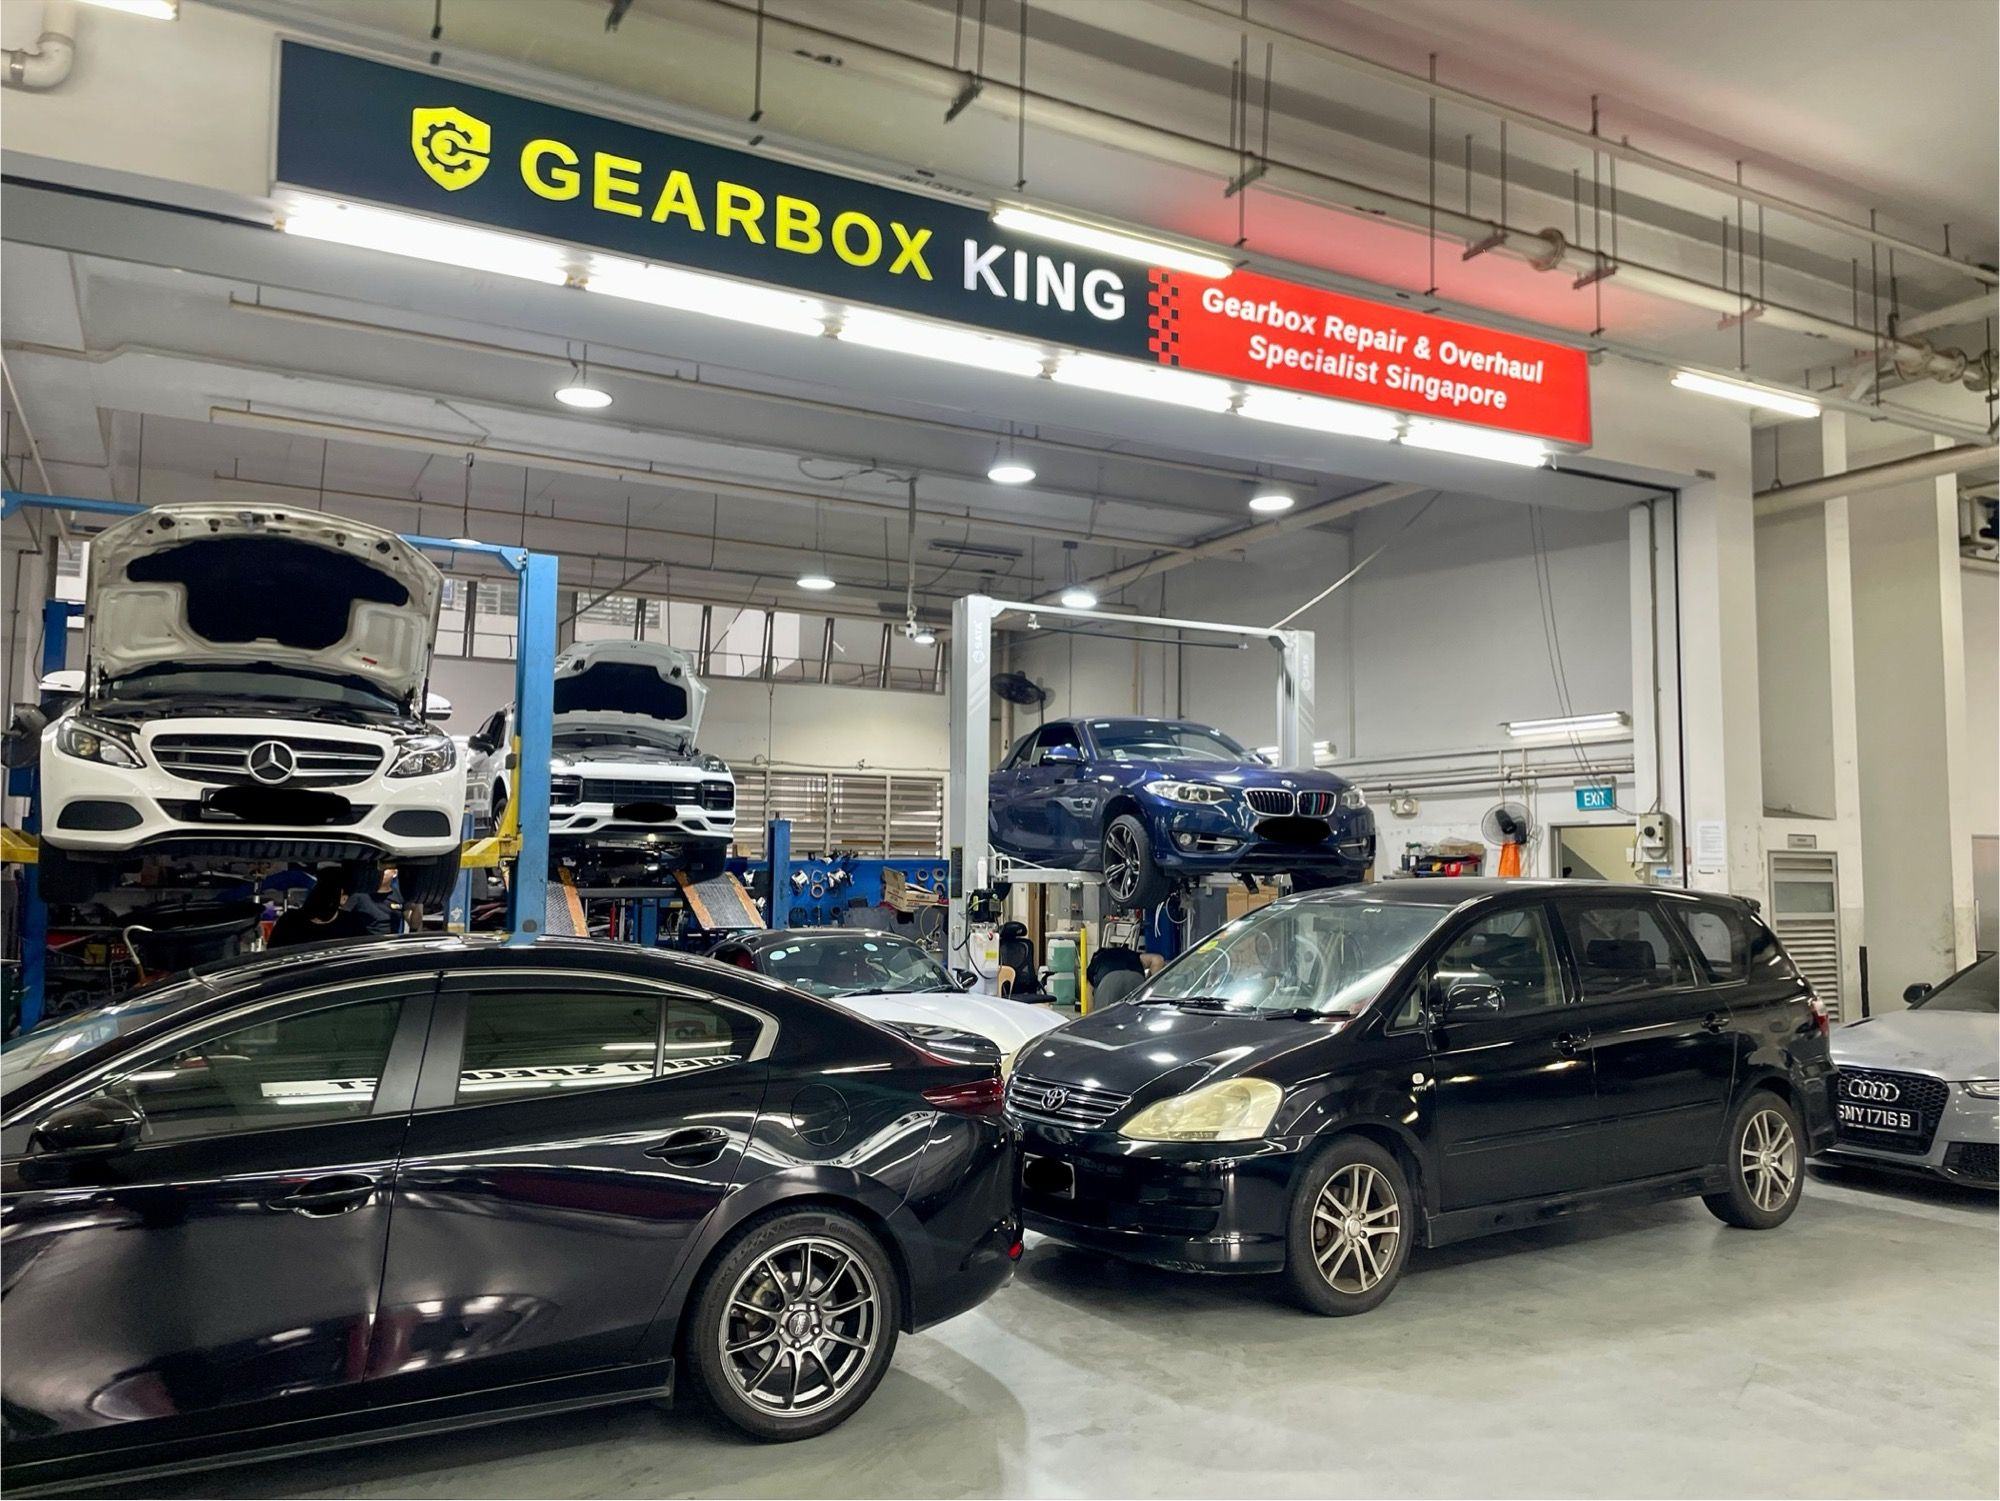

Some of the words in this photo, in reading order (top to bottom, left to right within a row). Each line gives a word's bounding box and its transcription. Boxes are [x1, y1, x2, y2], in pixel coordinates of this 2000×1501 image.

[520, 139, 933, 281] GEARBOX
[964, 238, 1126, 321] KING
[1202, 287, 1317, 335] Gearbox
[1323, 315, 1408, 353] Repair
[1413, 335, 1431, 361] &
[1438, 340, 1544, 384] Overhaul
[1248, 334, 1379, 385] Specialist
[1384, 363, 1507, 410] Singapore
[1584, 791, 1605, 807] EXIT
